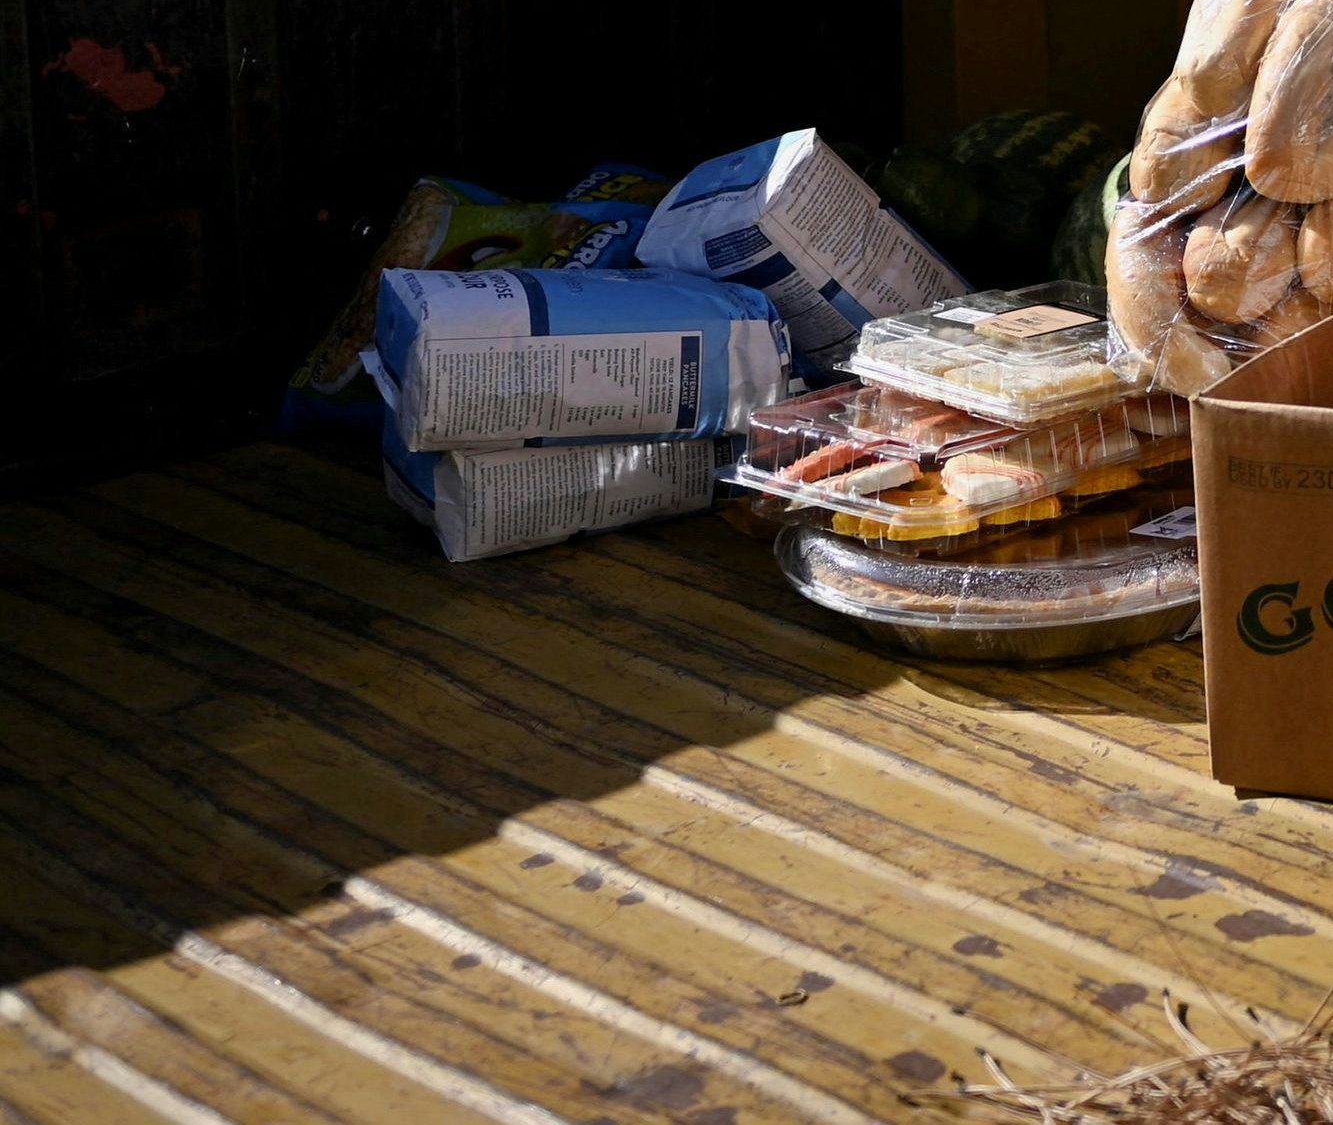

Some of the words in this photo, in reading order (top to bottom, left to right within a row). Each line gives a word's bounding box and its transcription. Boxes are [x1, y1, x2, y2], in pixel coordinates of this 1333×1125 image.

[488, 274, 514, 300] RPOSE
[681, 363, 689, 405] PANCAKES
[688, 361, 698, 409] BUTTERMILK
